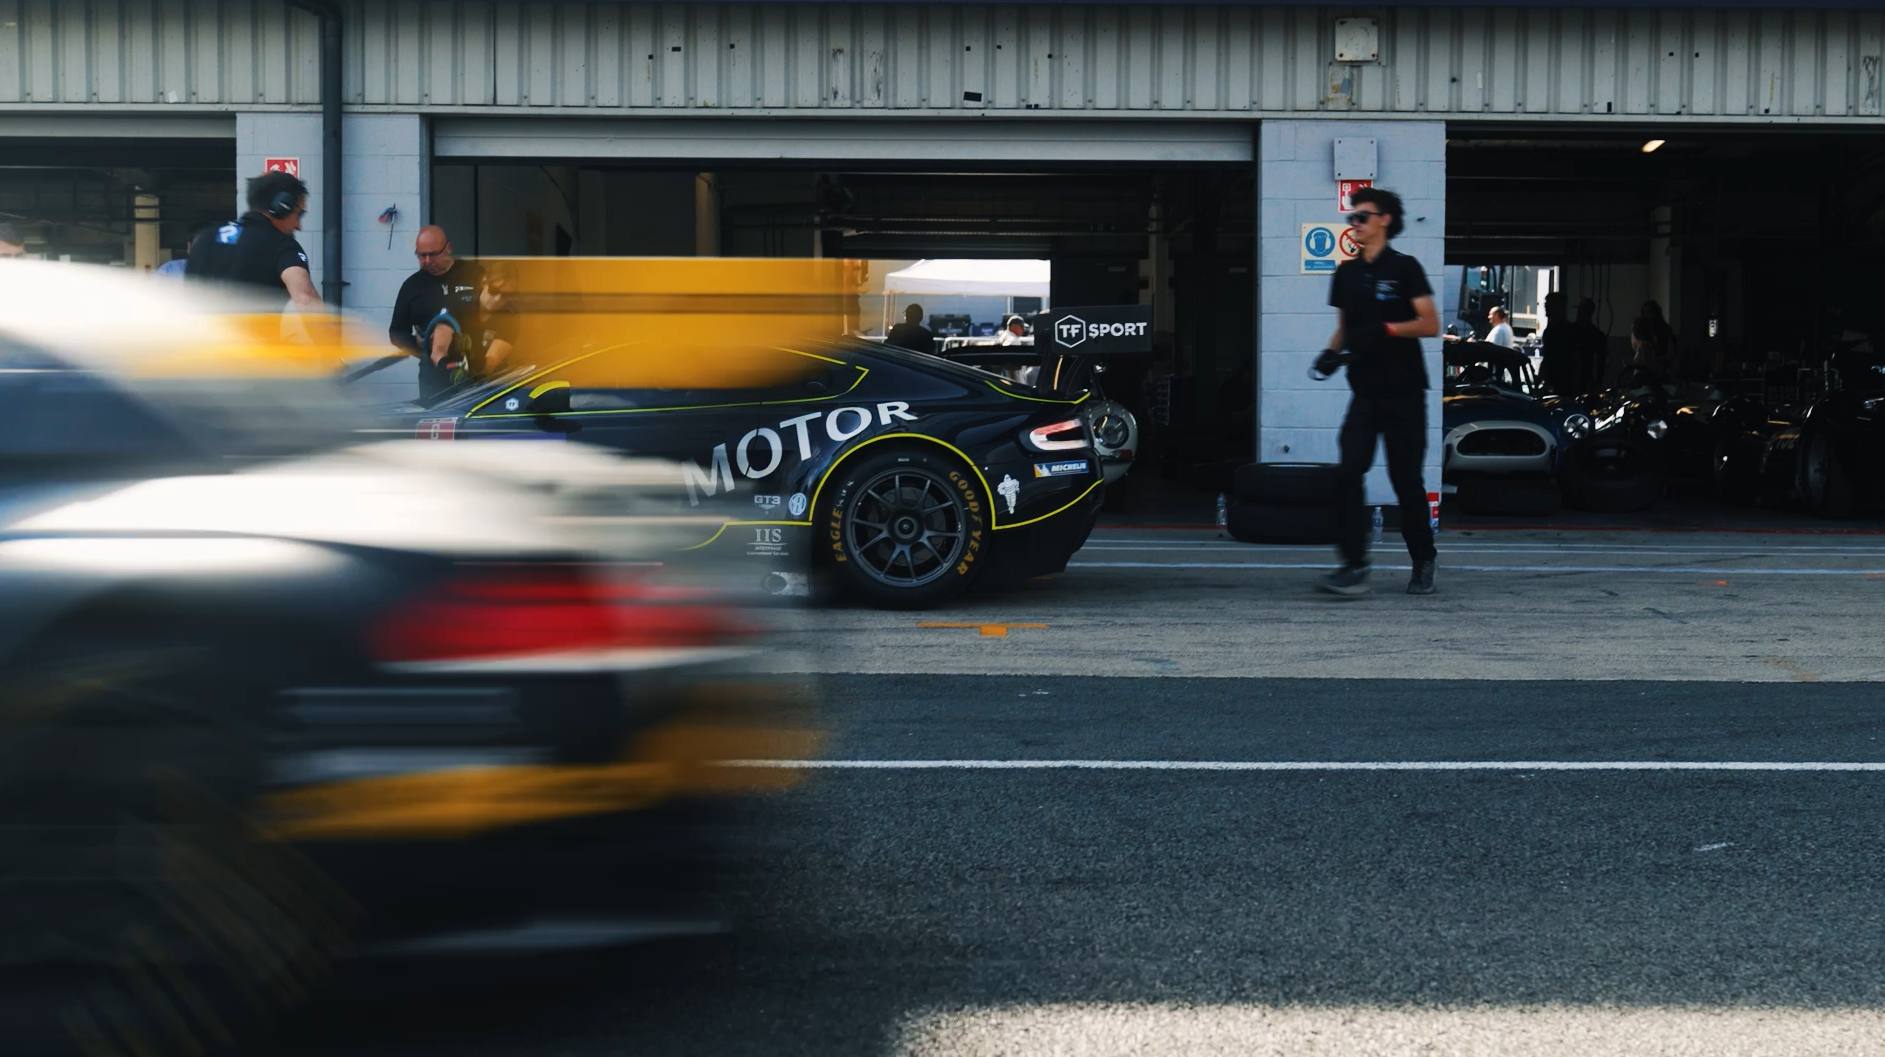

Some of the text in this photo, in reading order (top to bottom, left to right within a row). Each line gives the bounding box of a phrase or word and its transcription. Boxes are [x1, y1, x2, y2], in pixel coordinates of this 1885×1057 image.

[1058, 321, 1148, 339] TF SPORT
[681, 401, 918, 506] MOTOR
[754, 494, 781, 505] GT3
[755, 528, 782, 542] IIS
[830, 507, 848, 562] EAGLE
